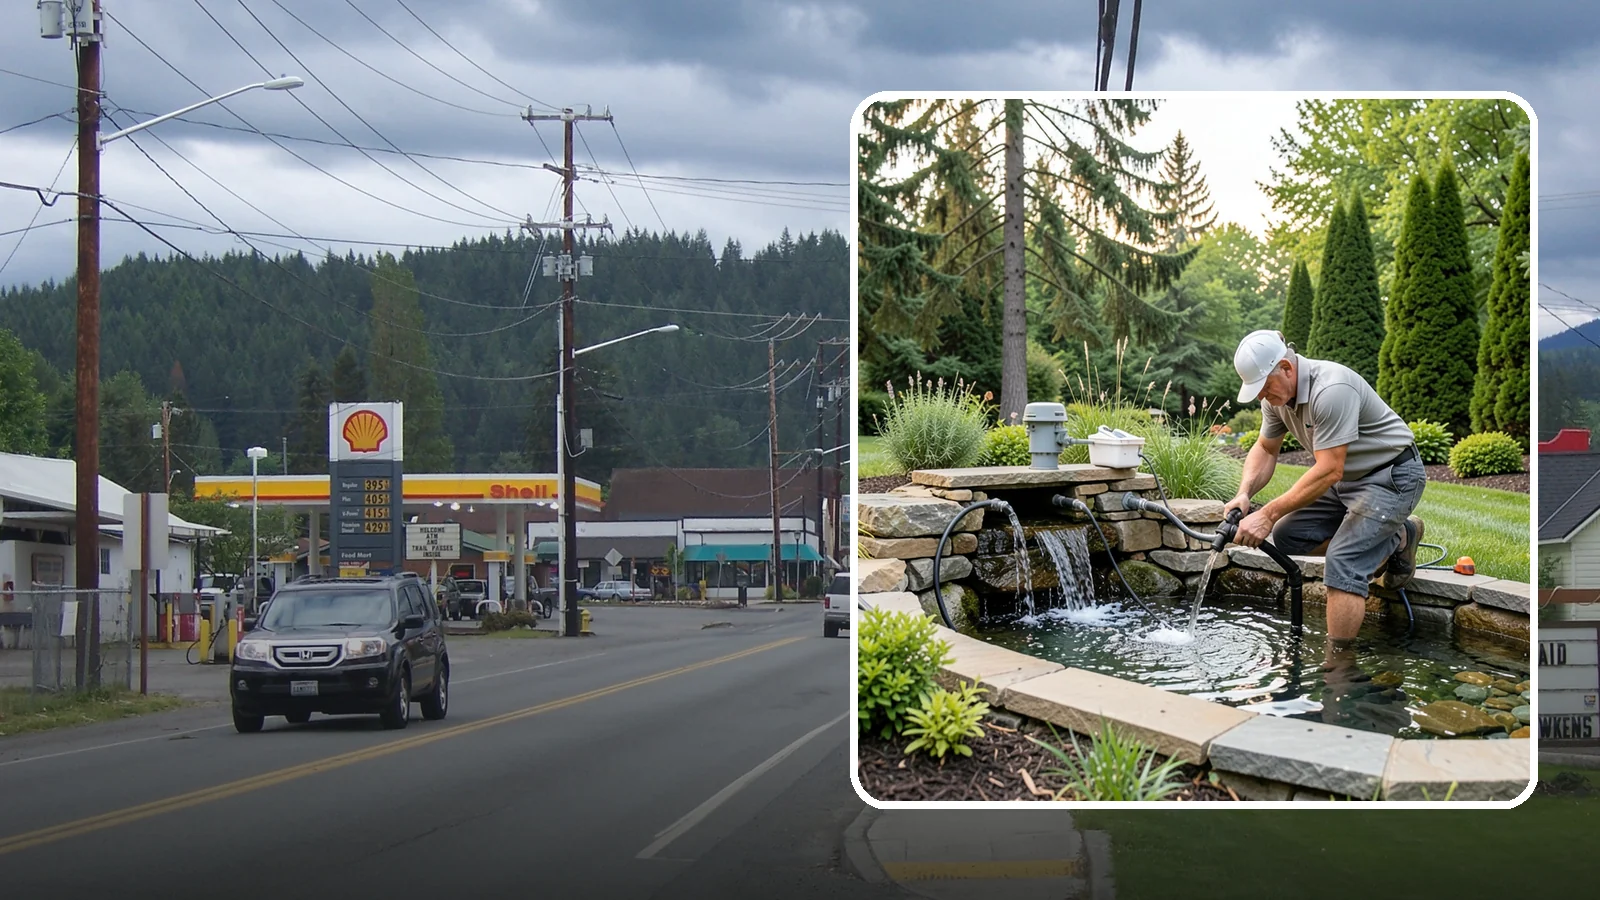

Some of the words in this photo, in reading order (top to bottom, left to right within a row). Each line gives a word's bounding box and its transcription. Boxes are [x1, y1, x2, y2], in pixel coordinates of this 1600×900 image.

[365, 480, 384, 490] 395
[490, 484, 548, 498] Shell
[365, 494, 384, 504] 405
[365, 508, 384, 518] 415
[365, 522, 384, 532] 429
